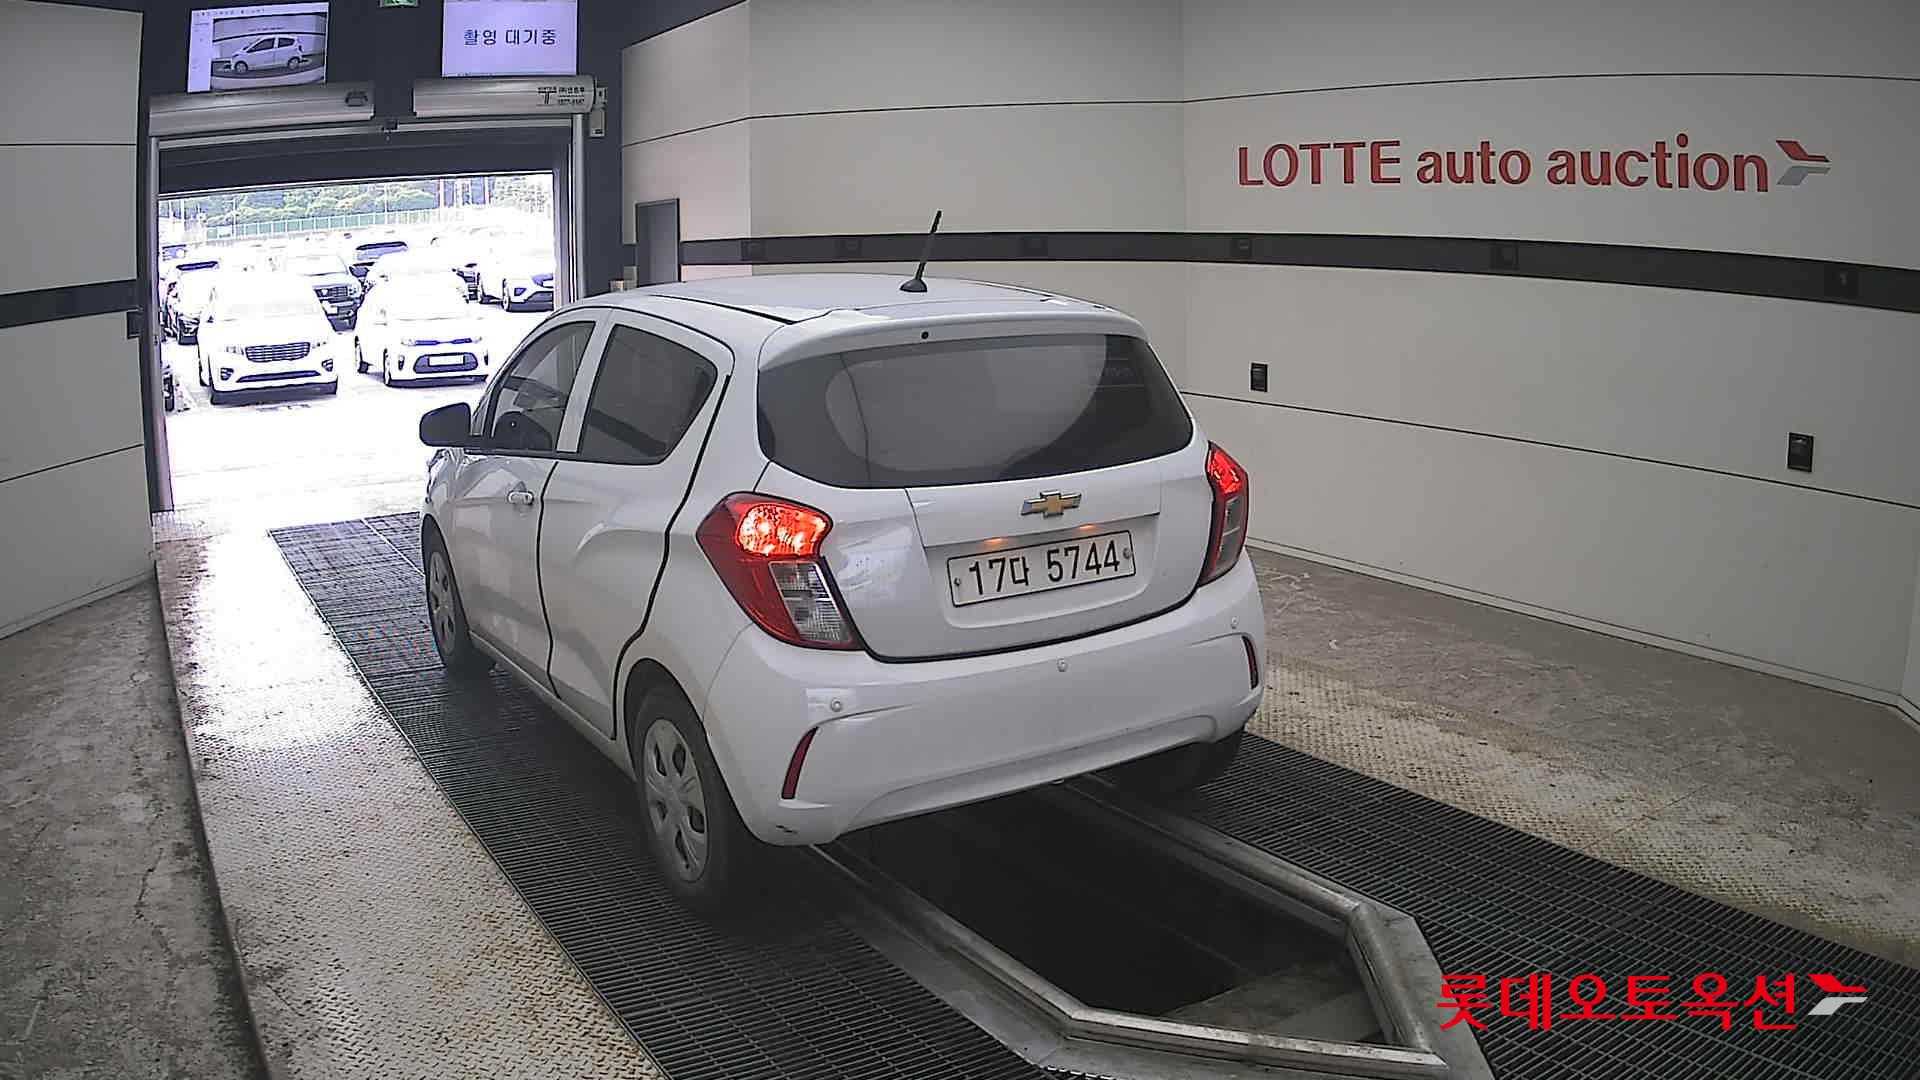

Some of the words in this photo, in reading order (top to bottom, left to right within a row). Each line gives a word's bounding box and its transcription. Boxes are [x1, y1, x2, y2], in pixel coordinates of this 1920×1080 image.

[505, 29, 556, 46] 대기중
[1238, 140, 1401, 187] LOTTE
[1416, 141, 1532, 184] auto
[1546, 133, 1769, 193] auction
[969, 556, 1029, 595] 17다
[1046, 540, 1120, 582] 5744
